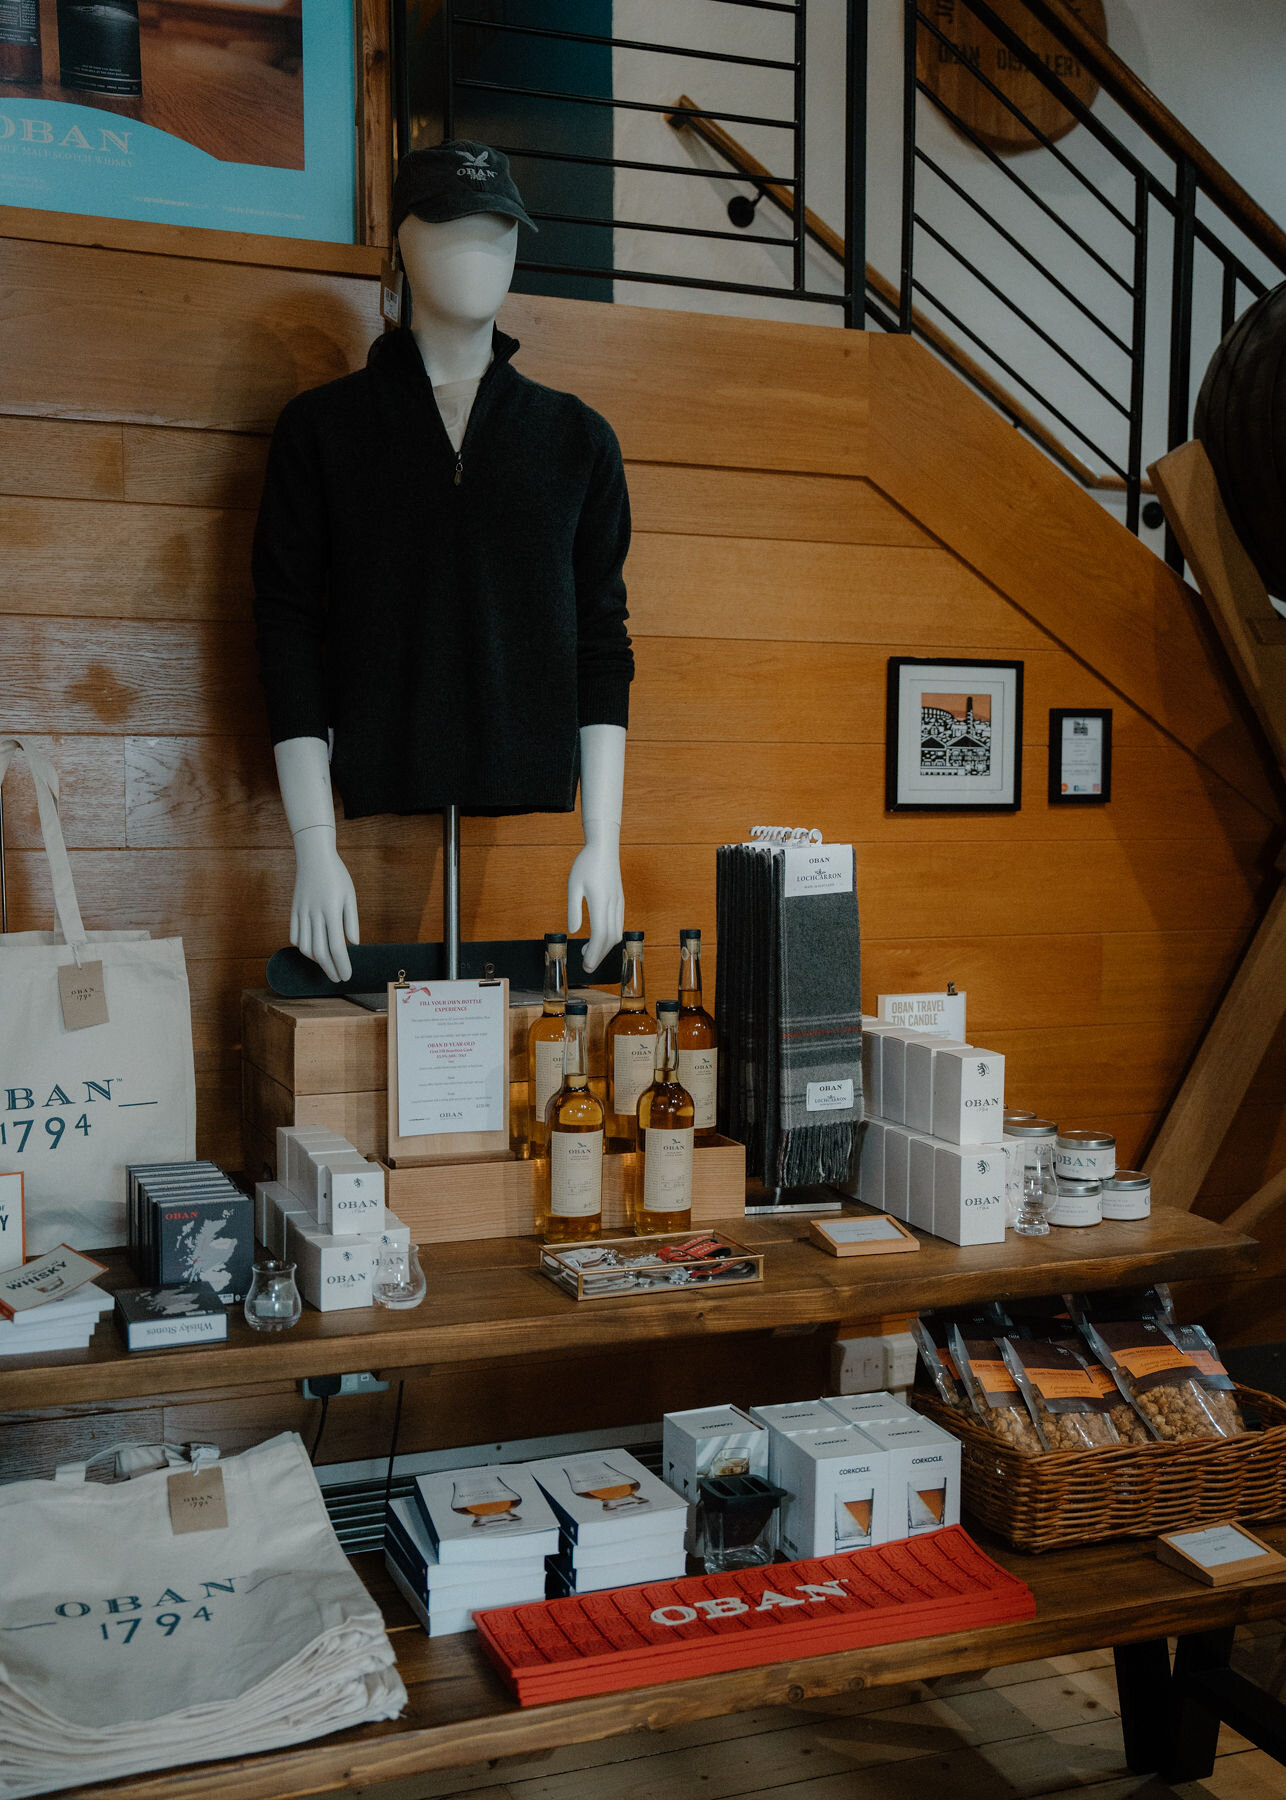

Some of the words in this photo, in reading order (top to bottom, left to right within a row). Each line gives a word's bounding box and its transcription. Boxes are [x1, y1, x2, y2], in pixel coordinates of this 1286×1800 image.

[456, 167, 498, 179] OBAN
[796, 872, 842, 882] LOCHCARRON
[891, 1001, 913, 1014] OBAN
[916, 1000, 944, 1013] TRAVEL
[891, 1014, 905, 1026] TIN
[908, 1013, 938, 1026] CANDLE
[4, 1079, 114, 1110] BAN
[965, 1098, 999, 1108] OBAN
[0, 1113, 91, 1152] 1794
[1057, 1154, 1097, 1168] OBAN
[338, 1200, 378, 1210] OBAN
[965, 1195, 1000, 1207] OBAN
[164, 1210, 199, 1220] OBAN
[6, 1261, 67, 1290] WHISKY
[327, 1272, 367, 1284] OBAN
[146, 1326, 177, 1335] Stones
[179, 1322, 213, 1332] Whisky
[55, 1578, 236, 1618] OBAN
[650, 1579, 849, 1628] OBAN
[100, 1605, 214, 1644] 1794
